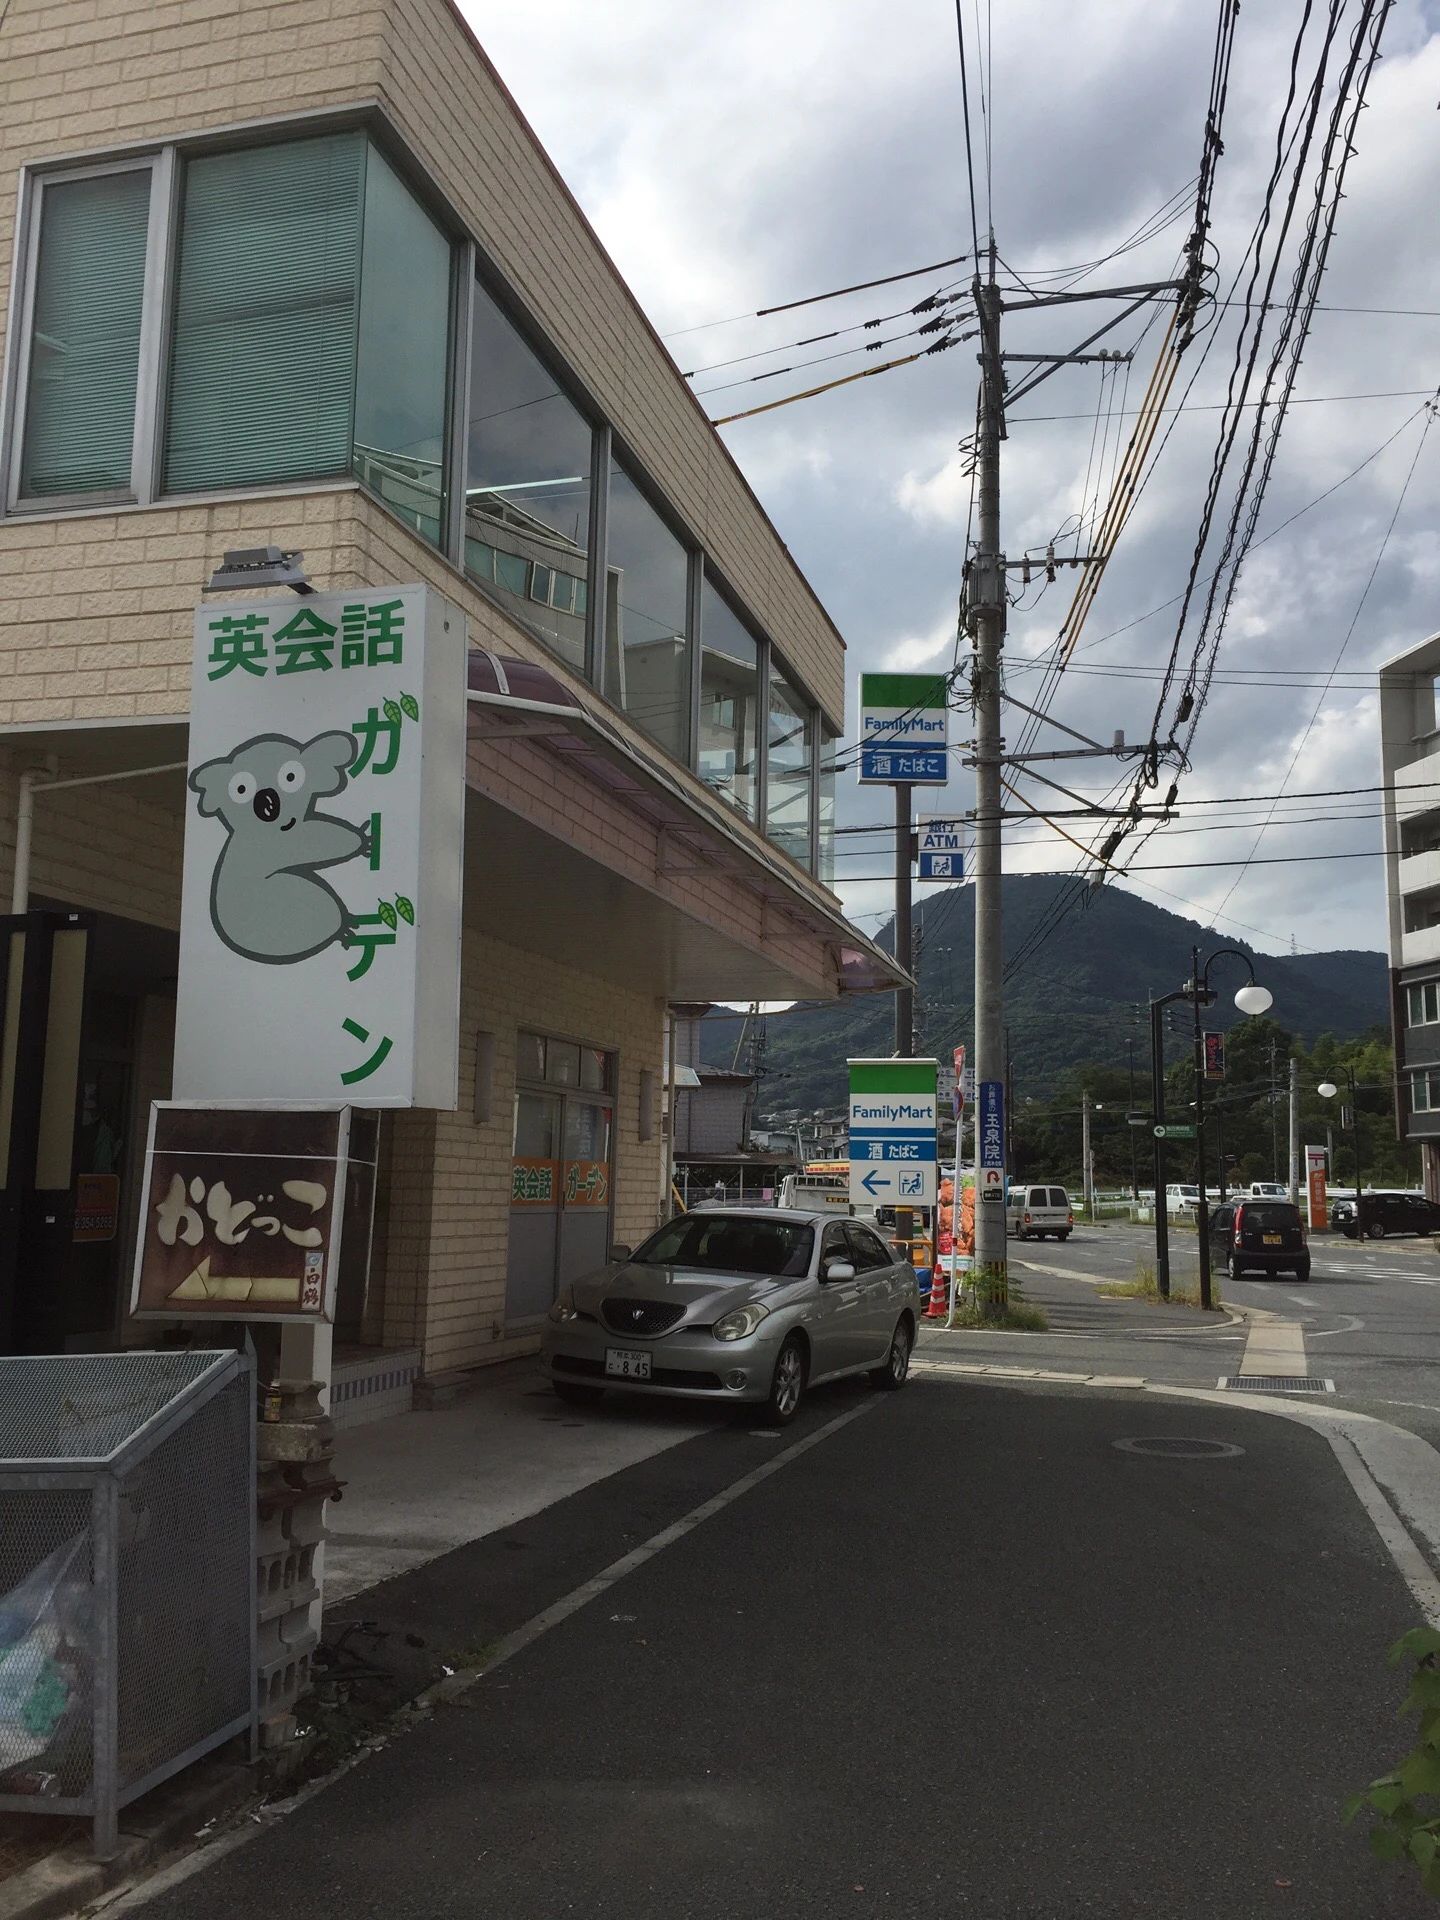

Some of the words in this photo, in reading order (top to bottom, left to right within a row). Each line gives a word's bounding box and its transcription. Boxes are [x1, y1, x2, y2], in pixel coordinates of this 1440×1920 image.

[206, 599, 406, 682] 英会話
[864, 716, 945, 733] FamilyMart
[871, 755, 892, 775] 酒
[898, 757, 940, 774] たばこ
[923, 834, 959, 849] ATM
[339, 691, 419, 1086] ガーデン
[852, 1104, 933, 1122] FamilyMart
[983, 1113, 1001, 1159] 玉泉院
[868, 1142, 883, 1159] 酒
[888, 1144, 920, 1159] たばこ
[512, 1164, 552, 1201] 英会話
[566, 1161, 608, 1202] ガーデン
